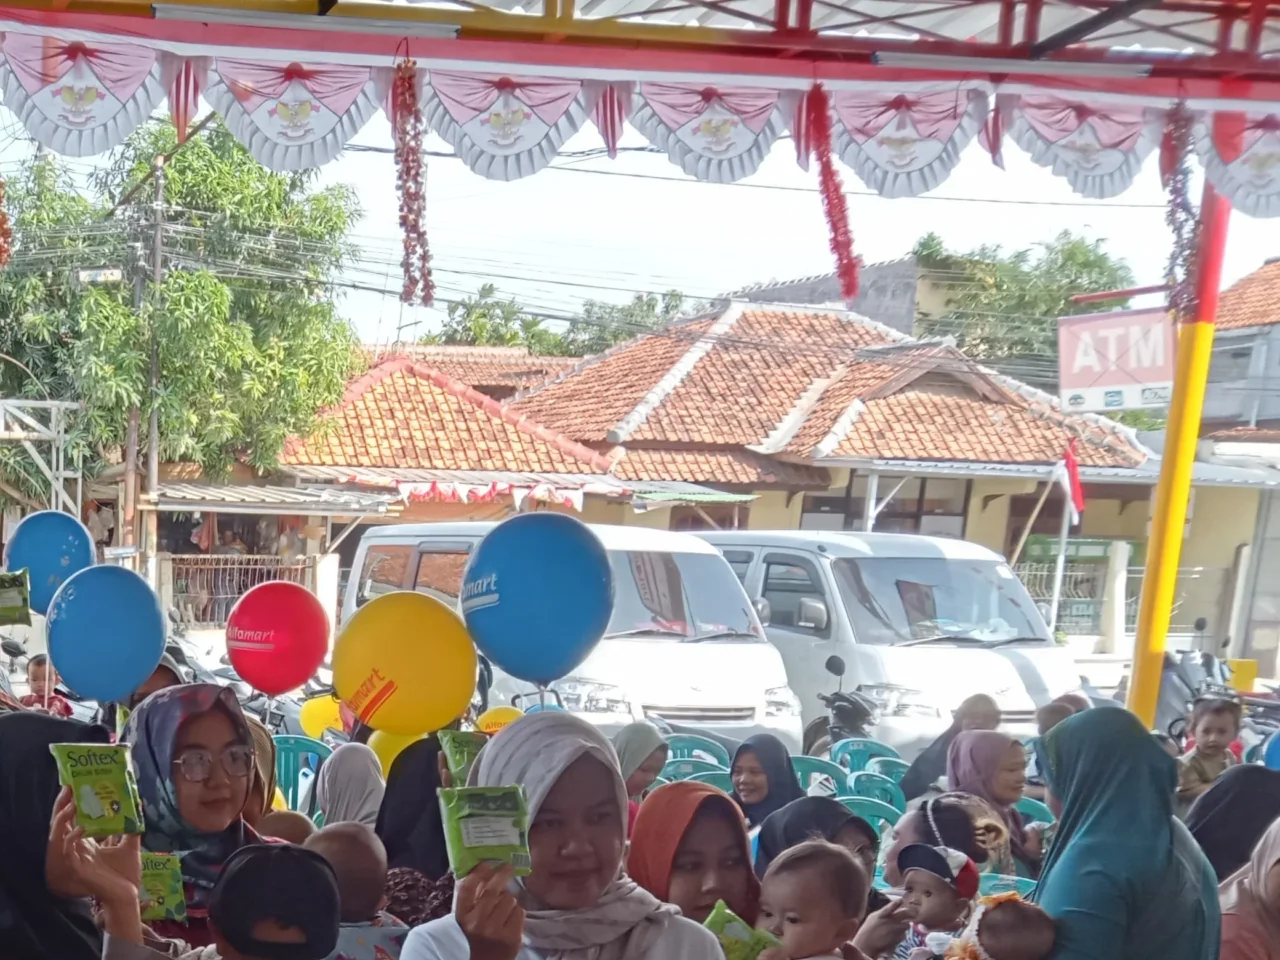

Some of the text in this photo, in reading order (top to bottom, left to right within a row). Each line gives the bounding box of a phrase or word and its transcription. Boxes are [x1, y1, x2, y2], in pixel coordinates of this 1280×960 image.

[1071, 322, 1164, 375] ATM
[67, 749, 118, 767] Softex
[141, 857, 170, 871] oftex
